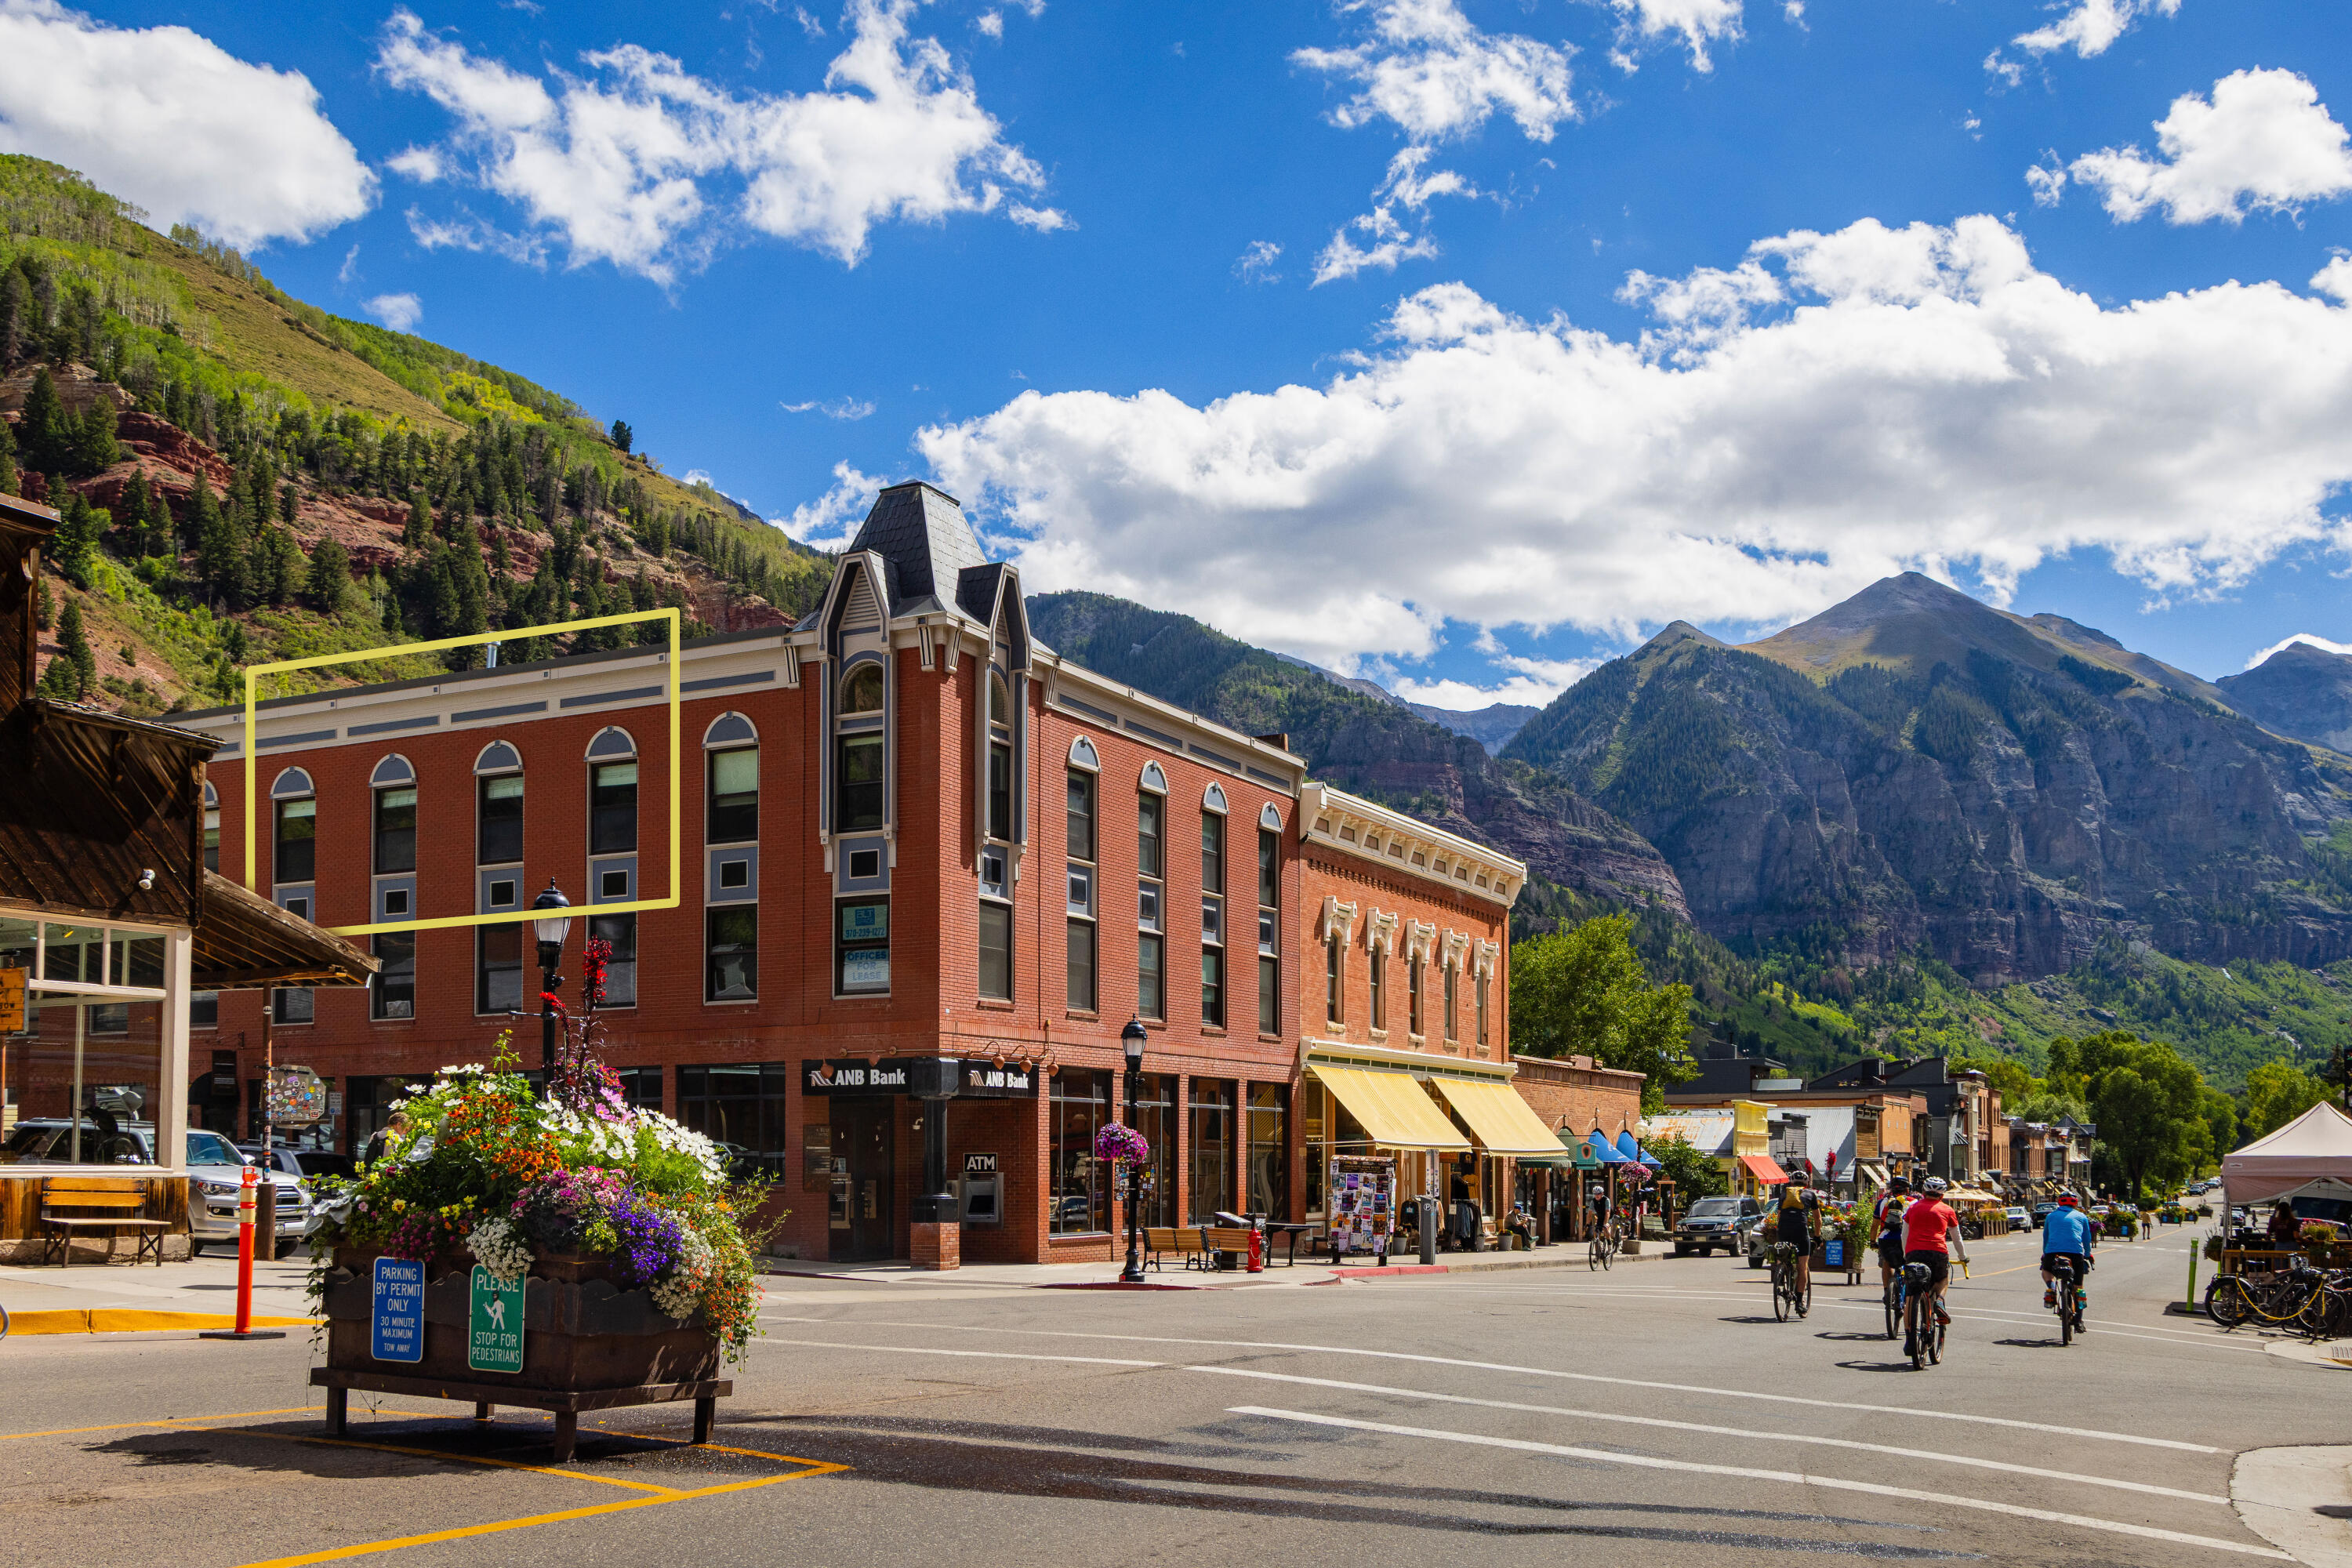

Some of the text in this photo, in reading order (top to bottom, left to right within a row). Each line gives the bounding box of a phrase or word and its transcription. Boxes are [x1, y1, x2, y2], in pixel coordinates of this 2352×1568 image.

[845, 927, 885, 938] 970-239-1272
[848, 951, 886, 960] OFFICES
[852, 971, 882, 981] LEASE
[834, 1069, 906, 1086] ANB Bank
[985, 1071, 1029, 1089] ANB Bank
[967, 1156, 995, 1170] ATM
[381, 1266, 417, 1281] PARKING
[376, 1282, 421, 1297] BY PERMIT
[477, 1274, 520, 1292] PLEASE
[387, 1298, 408, 1311] ONLY
[380, 1316, 416, 1328] 30 MINUTE
[382, 1327, 413, 1339] MAXIMUM
[475, 1331, 517, 1347] STOP FOR
[383, 1343, 410, 1352] TOW AWAY
[471, 1347, 520, 1363] PEDESTRIANS
